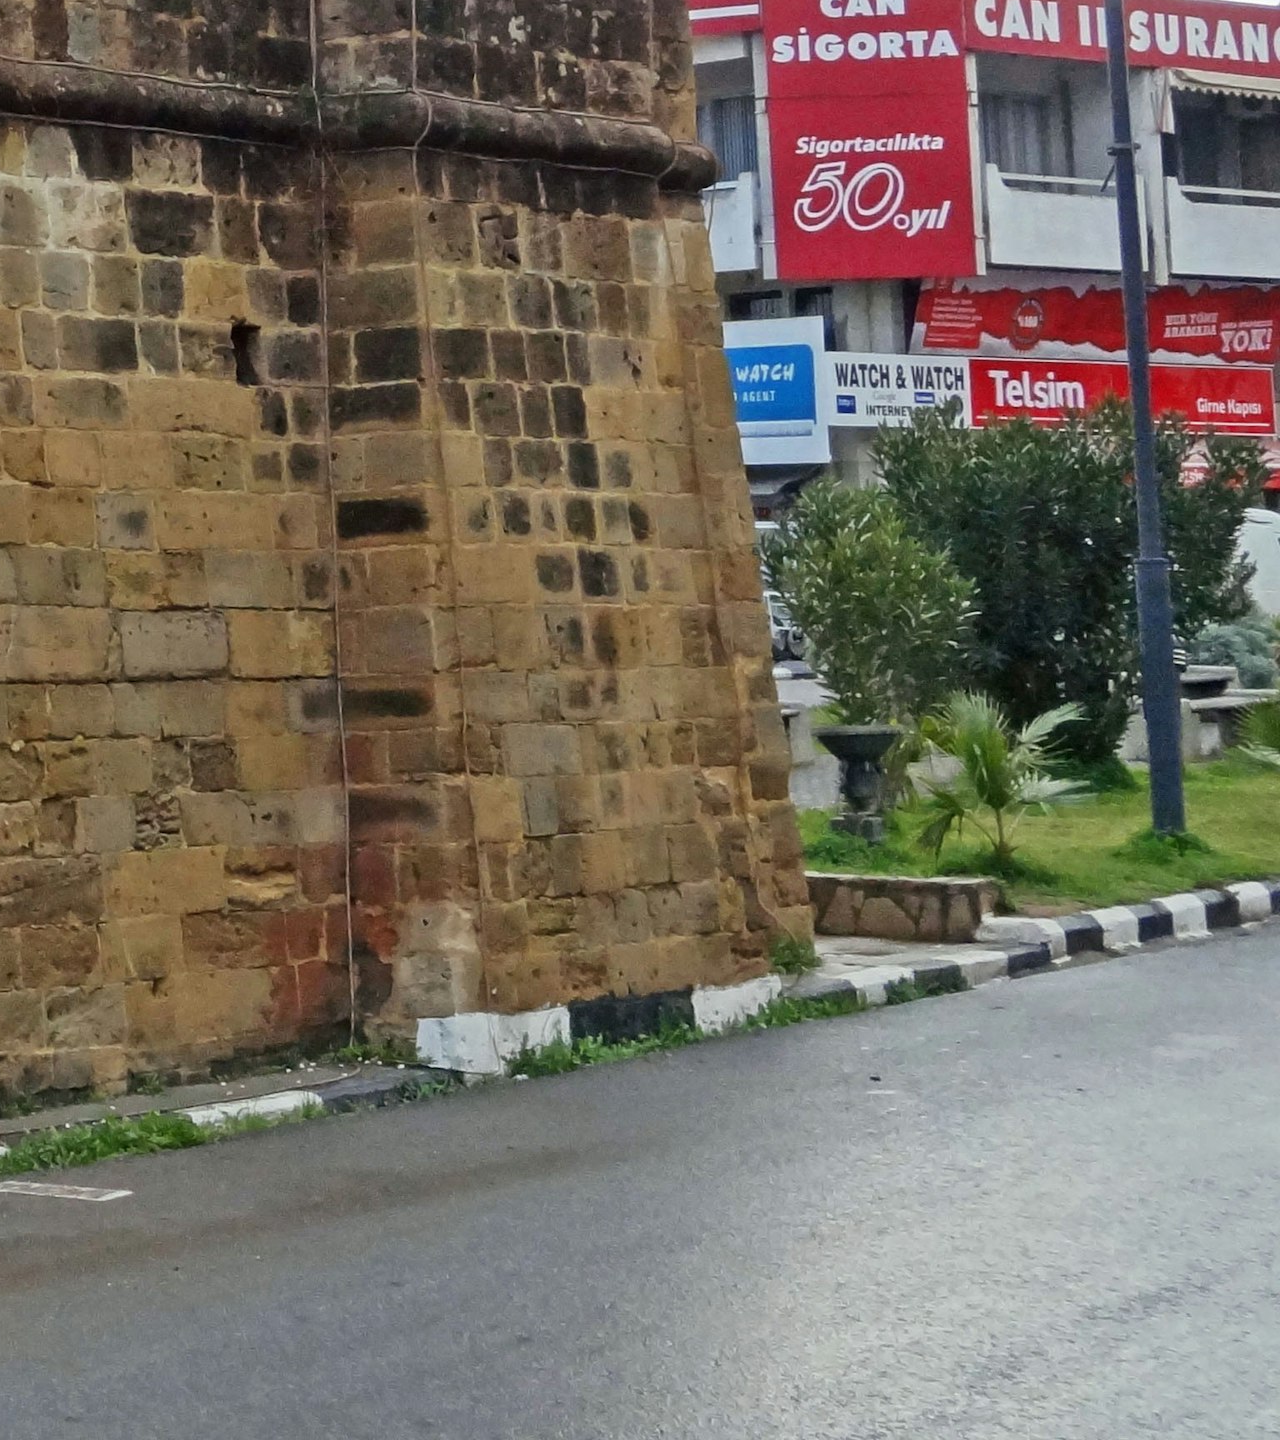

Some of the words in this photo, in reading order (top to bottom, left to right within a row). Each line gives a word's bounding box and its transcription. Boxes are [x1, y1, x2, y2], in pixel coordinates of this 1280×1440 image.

[772, 27, 959, 63] SİGORTA
[1078, 5, 1280, 63] ISURAN
[795, 133, 944, 158] Sigortacılıkta
[1220, 328, 1273, 353] YOK!
[735, 362, 795, 383] WATCH
[834, 362, 890, 389] WATCH
[896, 363, 907, 390] &
[911, 365, 965, 391] WATCH
[987, 369, 1085, 409] Telsim
[1197, 398, 1226, 414] Girne
